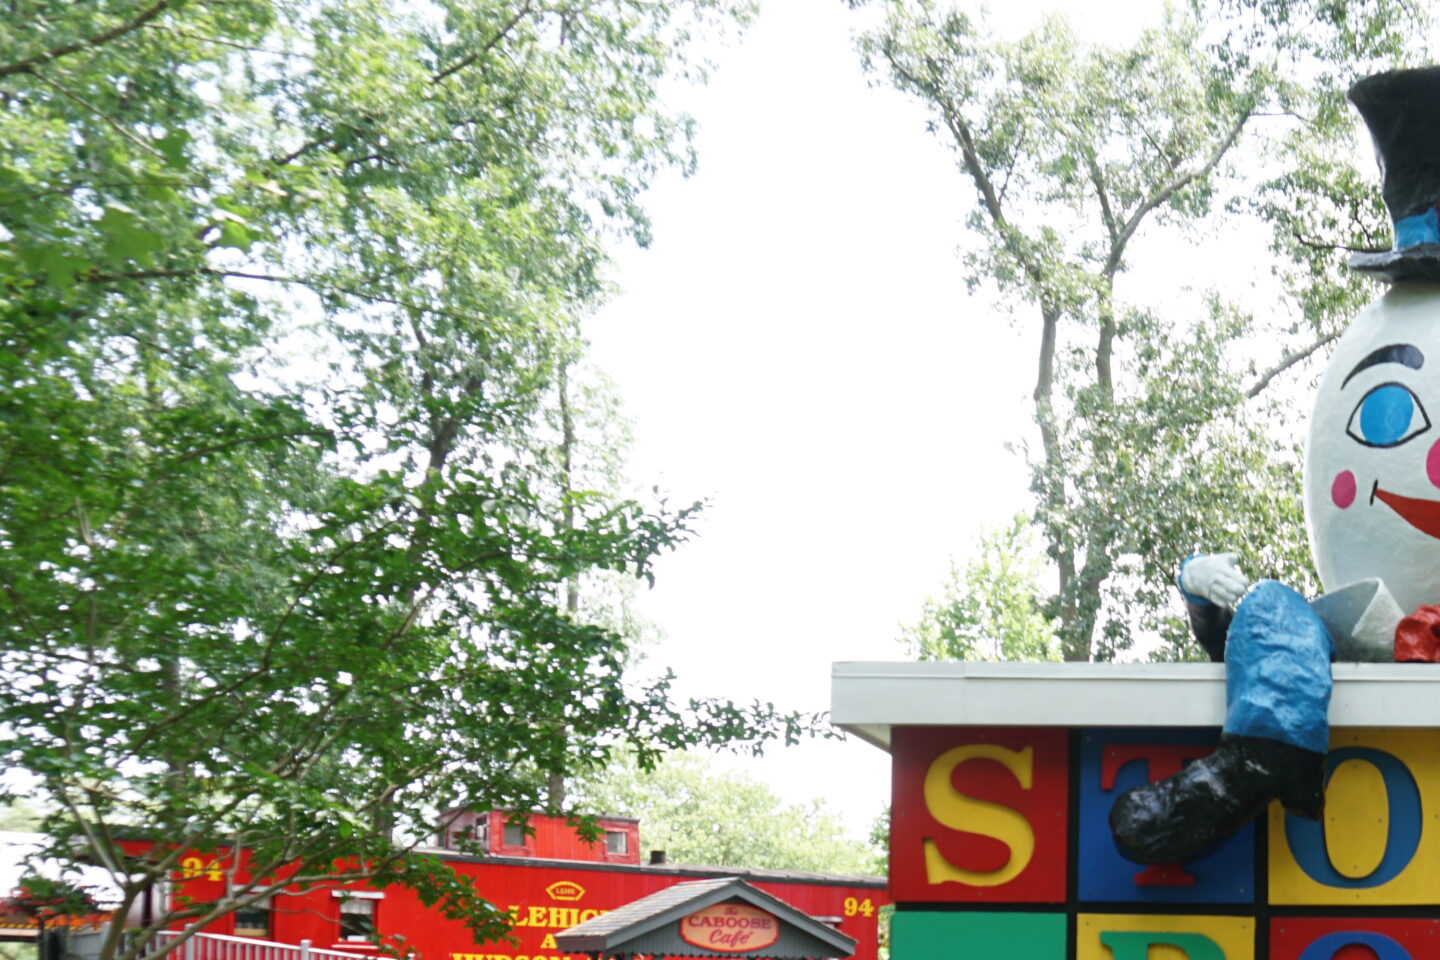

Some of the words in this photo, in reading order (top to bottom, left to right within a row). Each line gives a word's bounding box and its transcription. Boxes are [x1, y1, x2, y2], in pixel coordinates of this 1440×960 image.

[182, 857, 224, 881] 94
[507, 905, 612, 928] LEHI
[843, 896, 875, 917] 94
[688, 915, 771, 929] CABOOSE
